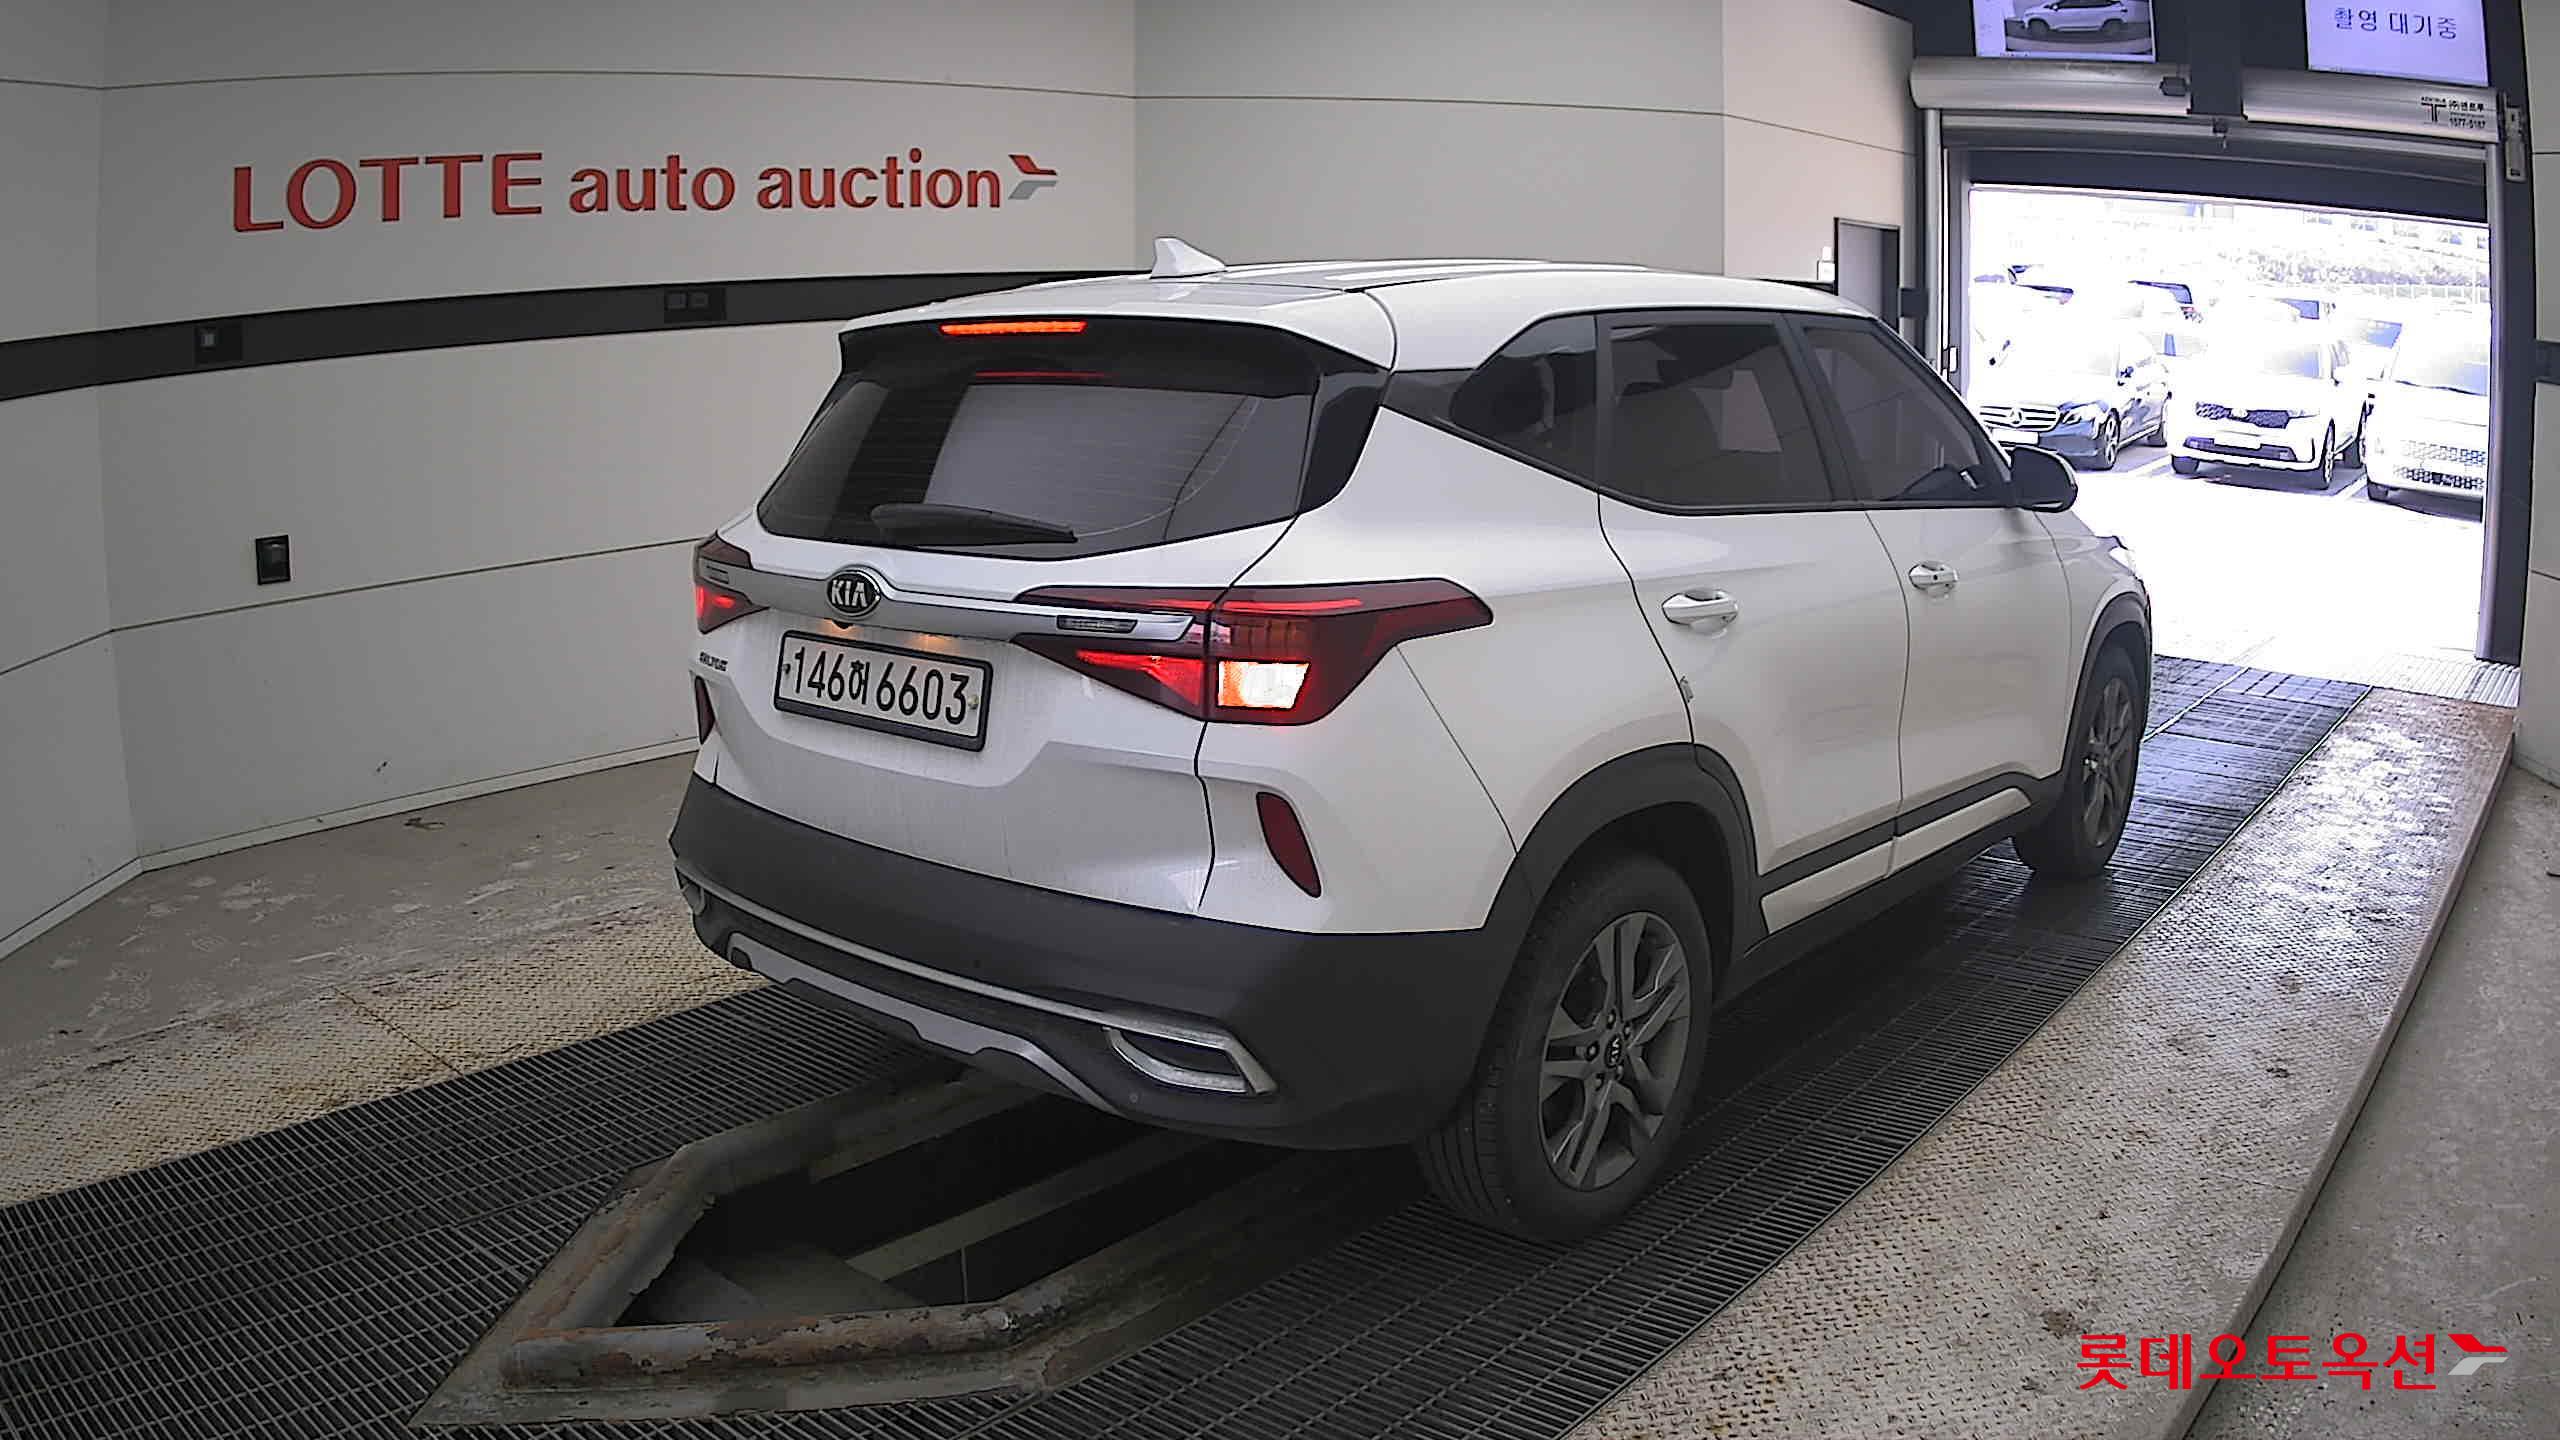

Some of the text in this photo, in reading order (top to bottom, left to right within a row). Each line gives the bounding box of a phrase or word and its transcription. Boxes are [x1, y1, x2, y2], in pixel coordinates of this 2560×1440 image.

[2335, 7, 2457, 40] 촬영 대기중
[233, 148, 1001, 232] LOTTE auto auction
[831, 579, 867, 608] KIA
